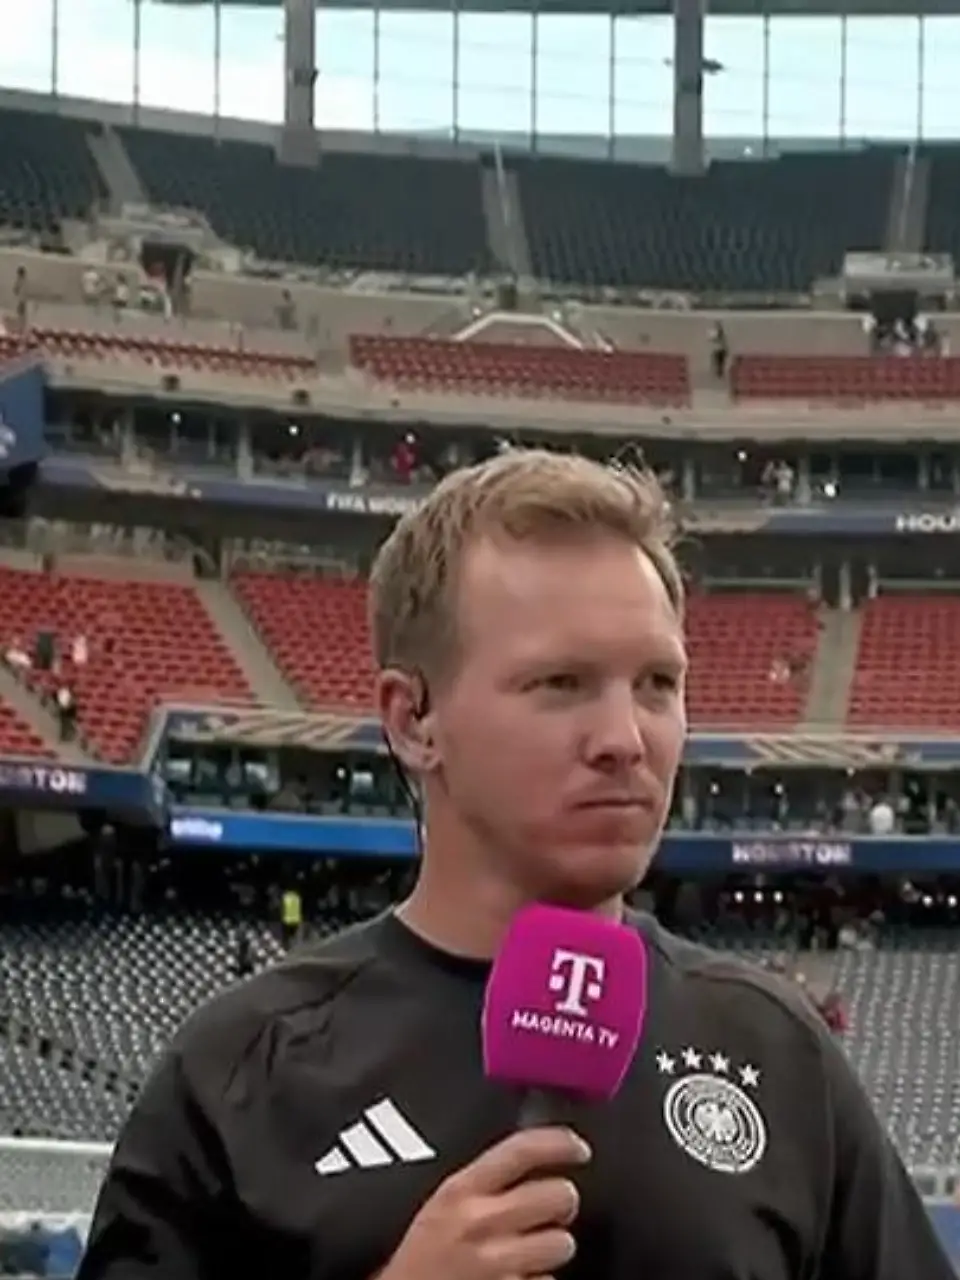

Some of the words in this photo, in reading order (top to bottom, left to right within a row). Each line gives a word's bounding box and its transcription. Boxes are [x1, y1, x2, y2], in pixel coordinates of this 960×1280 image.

[732, 841, 852, 864] HOUSTON
[549, 948, 604, 1017] T
[511, 1009, 595, 1042] MAGENTA
[598, 1026, 619, 1049] TV
